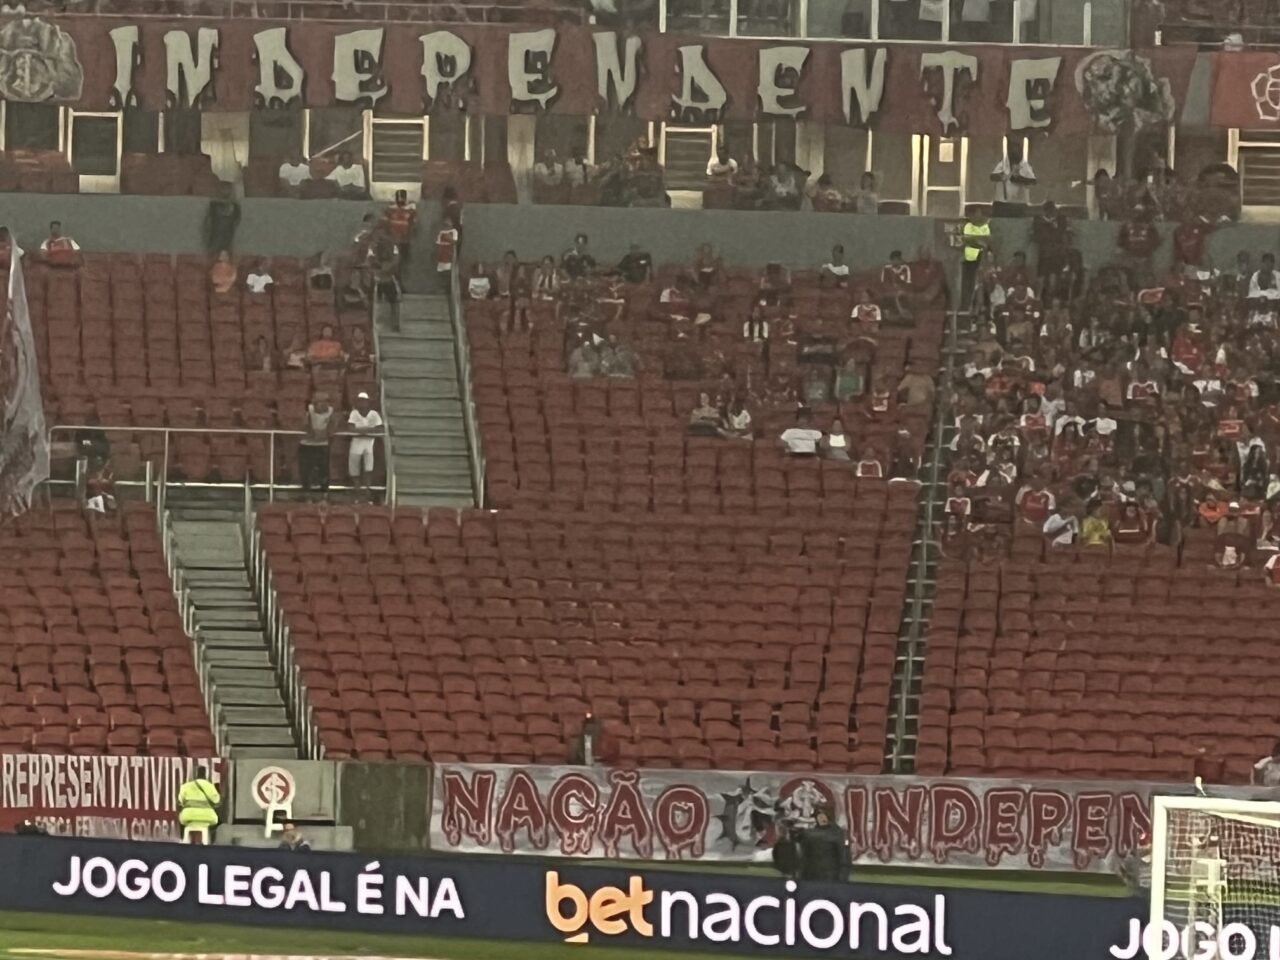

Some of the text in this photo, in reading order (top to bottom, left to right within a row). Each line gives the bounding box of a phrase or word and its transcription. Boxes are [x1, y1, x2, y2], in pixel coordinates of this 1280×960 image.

[110, 25, 1062, 130] INDEPENDENTE
[52, 855, 466, 919] JOGO LEGAL É NA
[545, 869, 953, 956] betnacional
